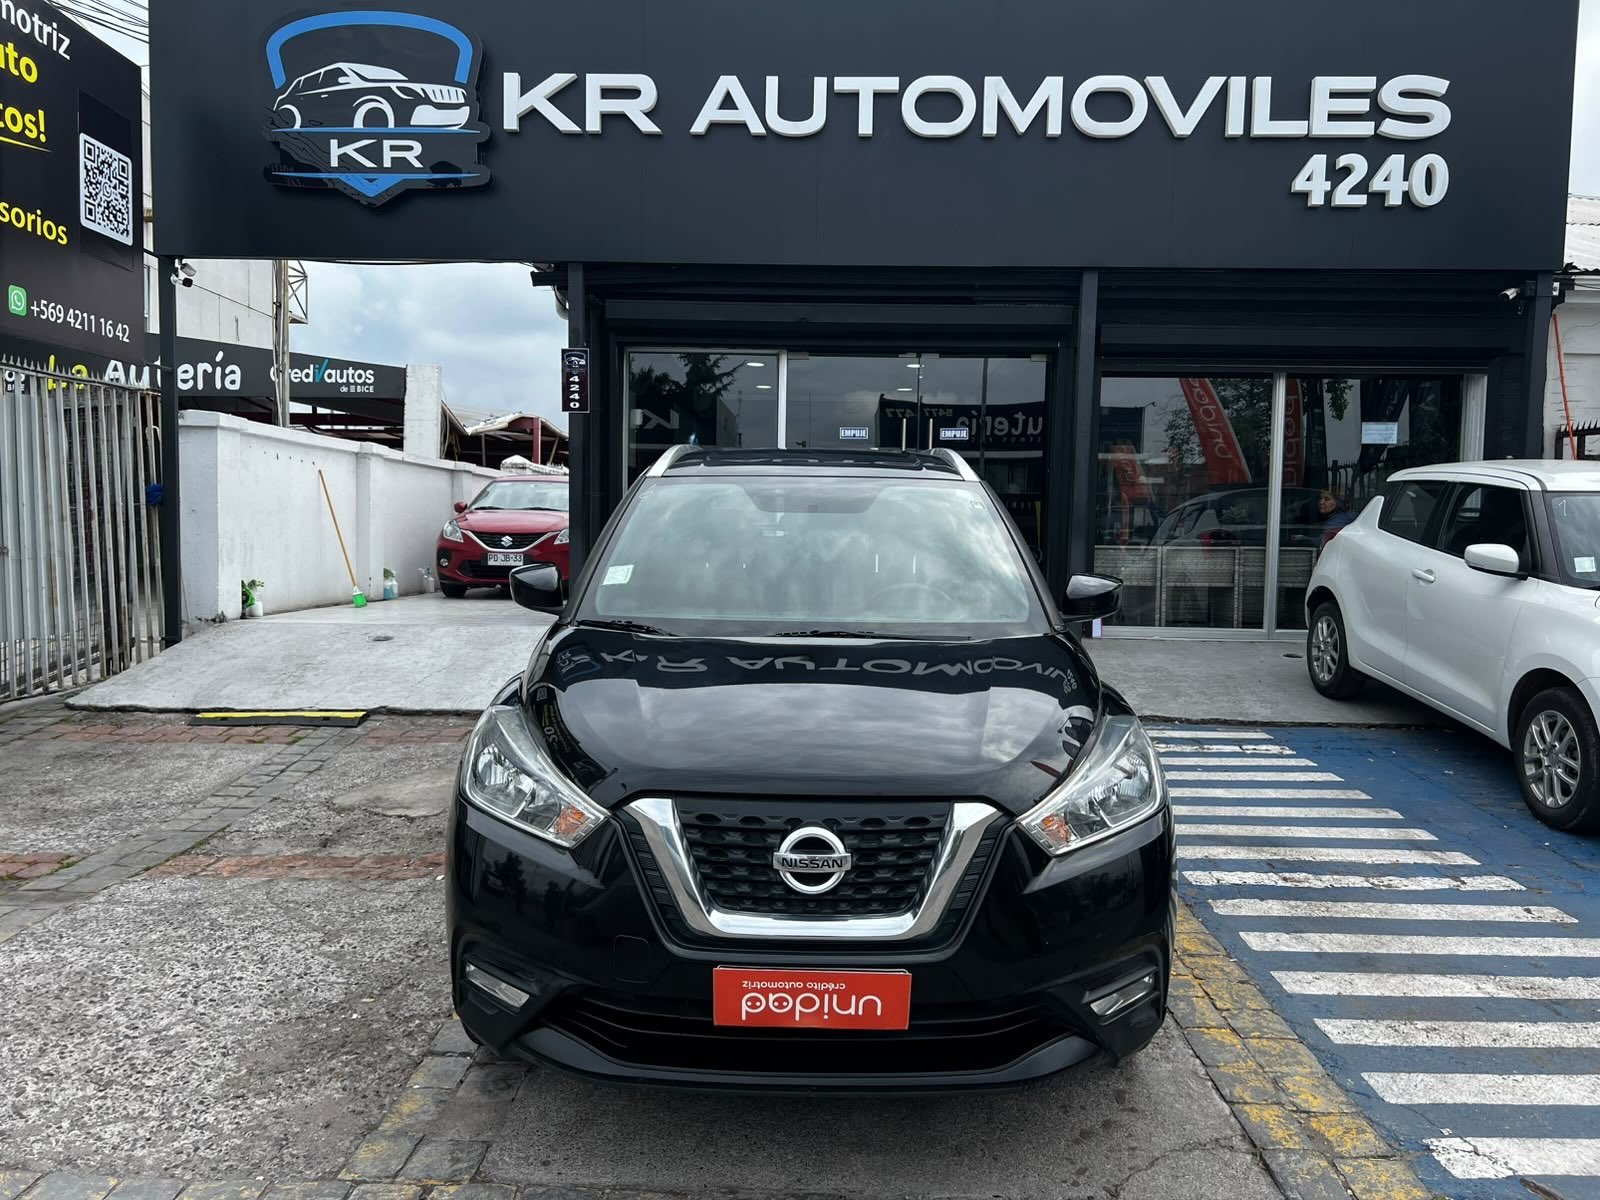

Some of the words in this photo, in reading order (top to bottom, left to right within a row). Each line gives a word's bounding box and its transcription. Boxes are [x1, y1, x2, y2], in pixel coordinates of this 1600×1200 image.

[503, 72, 663, 135] KR
[690, 74, 1452, 139] AUTOMOVILES
[330, 139, 423, 168] KR
[1292, 153, 1450, 207] 4240
[30, 299, 64, 324] +569
[66, 308, 96, 333] 4211
[99, 317, 114, 338] 16
[115, 323, 130, 343] 42
[340, 385, 349, 393] de
[356, 385, 374, 393] BICE
[569, 375, 580, 409] 4240
[841, 429, 868, 438] EMPUJE
[941, 430, 968, 439] EMPUJE
[781, 857, 844, 869] NISSAN
[742, 980, 804, 990] automotriz
[806, 980, 846, 991] crédito
[741, 993, 882, 1021] unidad
